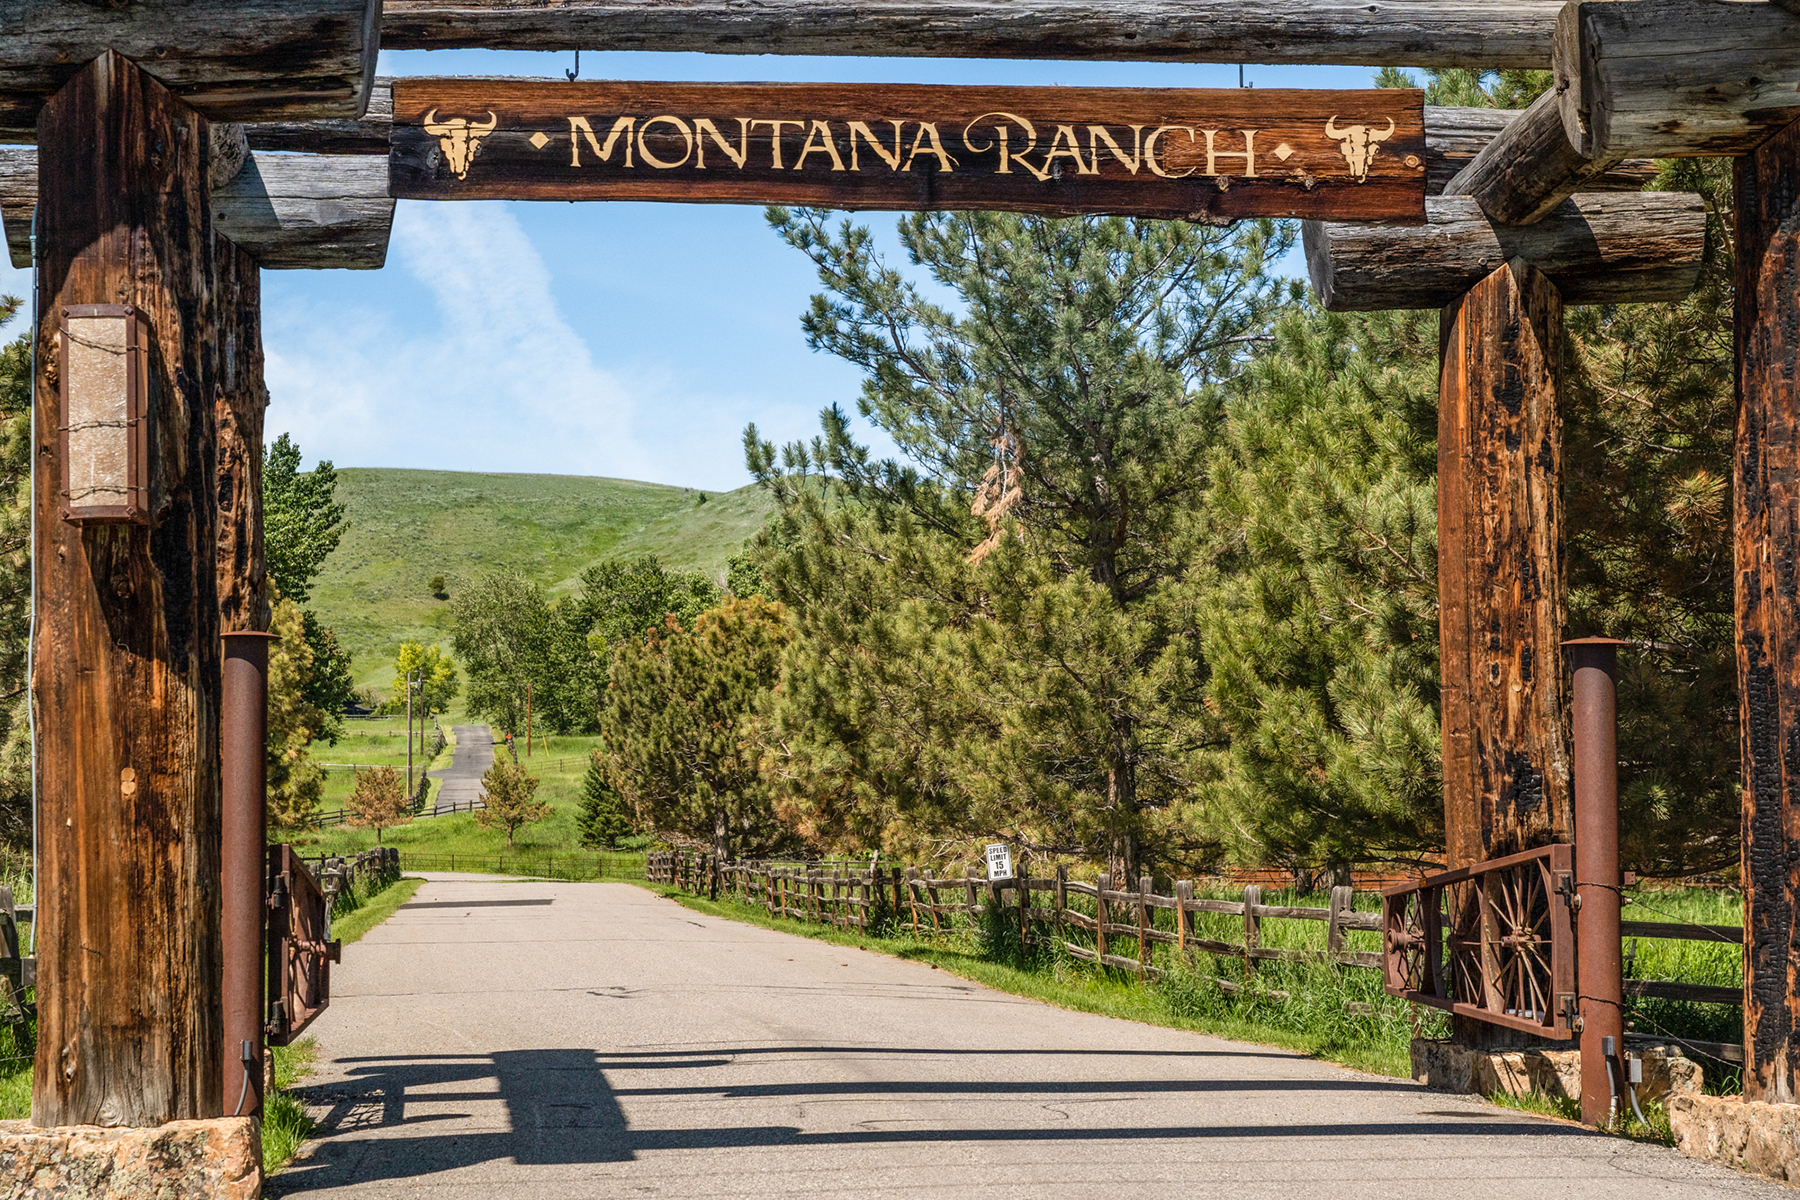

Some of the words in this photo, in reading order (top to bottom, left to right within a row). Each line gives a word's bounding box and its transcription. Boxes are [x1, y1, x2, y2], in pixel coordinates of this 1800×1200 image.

[567, 114, 960, 173] MONTANA
[963, 111, 1259, 182] RANCH
[988, 846, 1007, 854] SPEED
[995, 861, 1004, 869] 15
